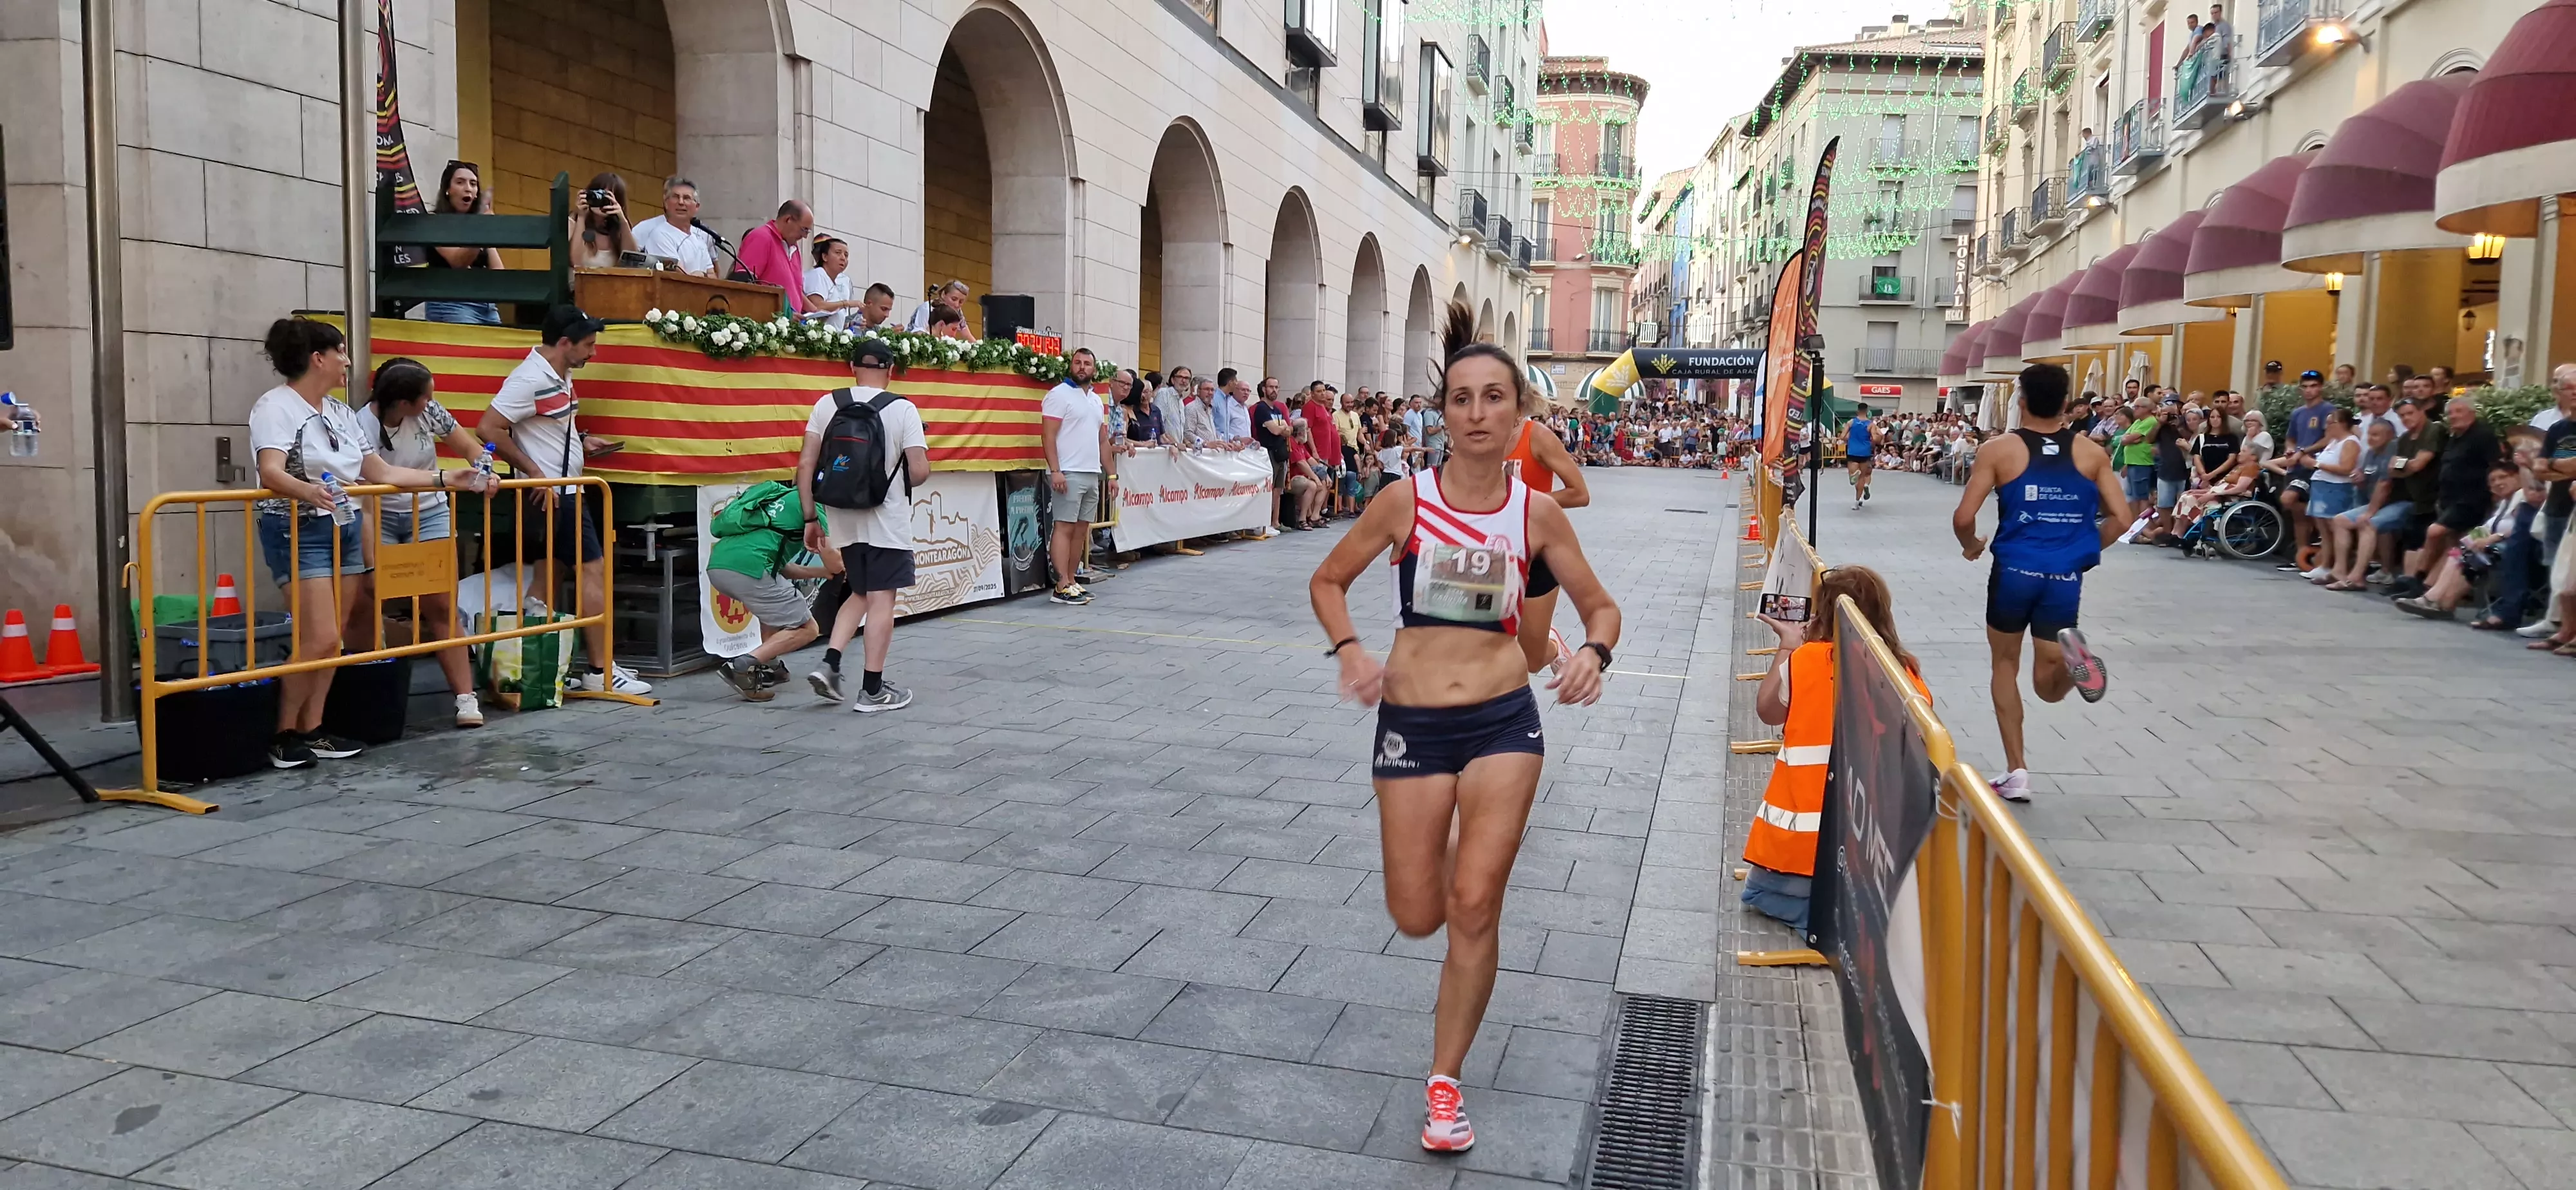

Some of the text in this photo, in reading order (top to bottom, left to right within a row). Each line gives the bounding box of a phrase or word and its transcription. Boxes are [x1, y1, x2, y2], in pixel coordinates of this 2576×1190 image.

[1954, 234, 1969, 307] HOSTAL
[1689, 355, 1754, 366] FUNDACIÓN
[1122, 487, 1153, 508] Alcampo
[1159, 484, 1188, 504] Alcampo
[1194, 482, 1225, 501] Alcampo
[1229, 480, 1260, 498] Alcampo
[1452, 548, 1491, 576] 19
